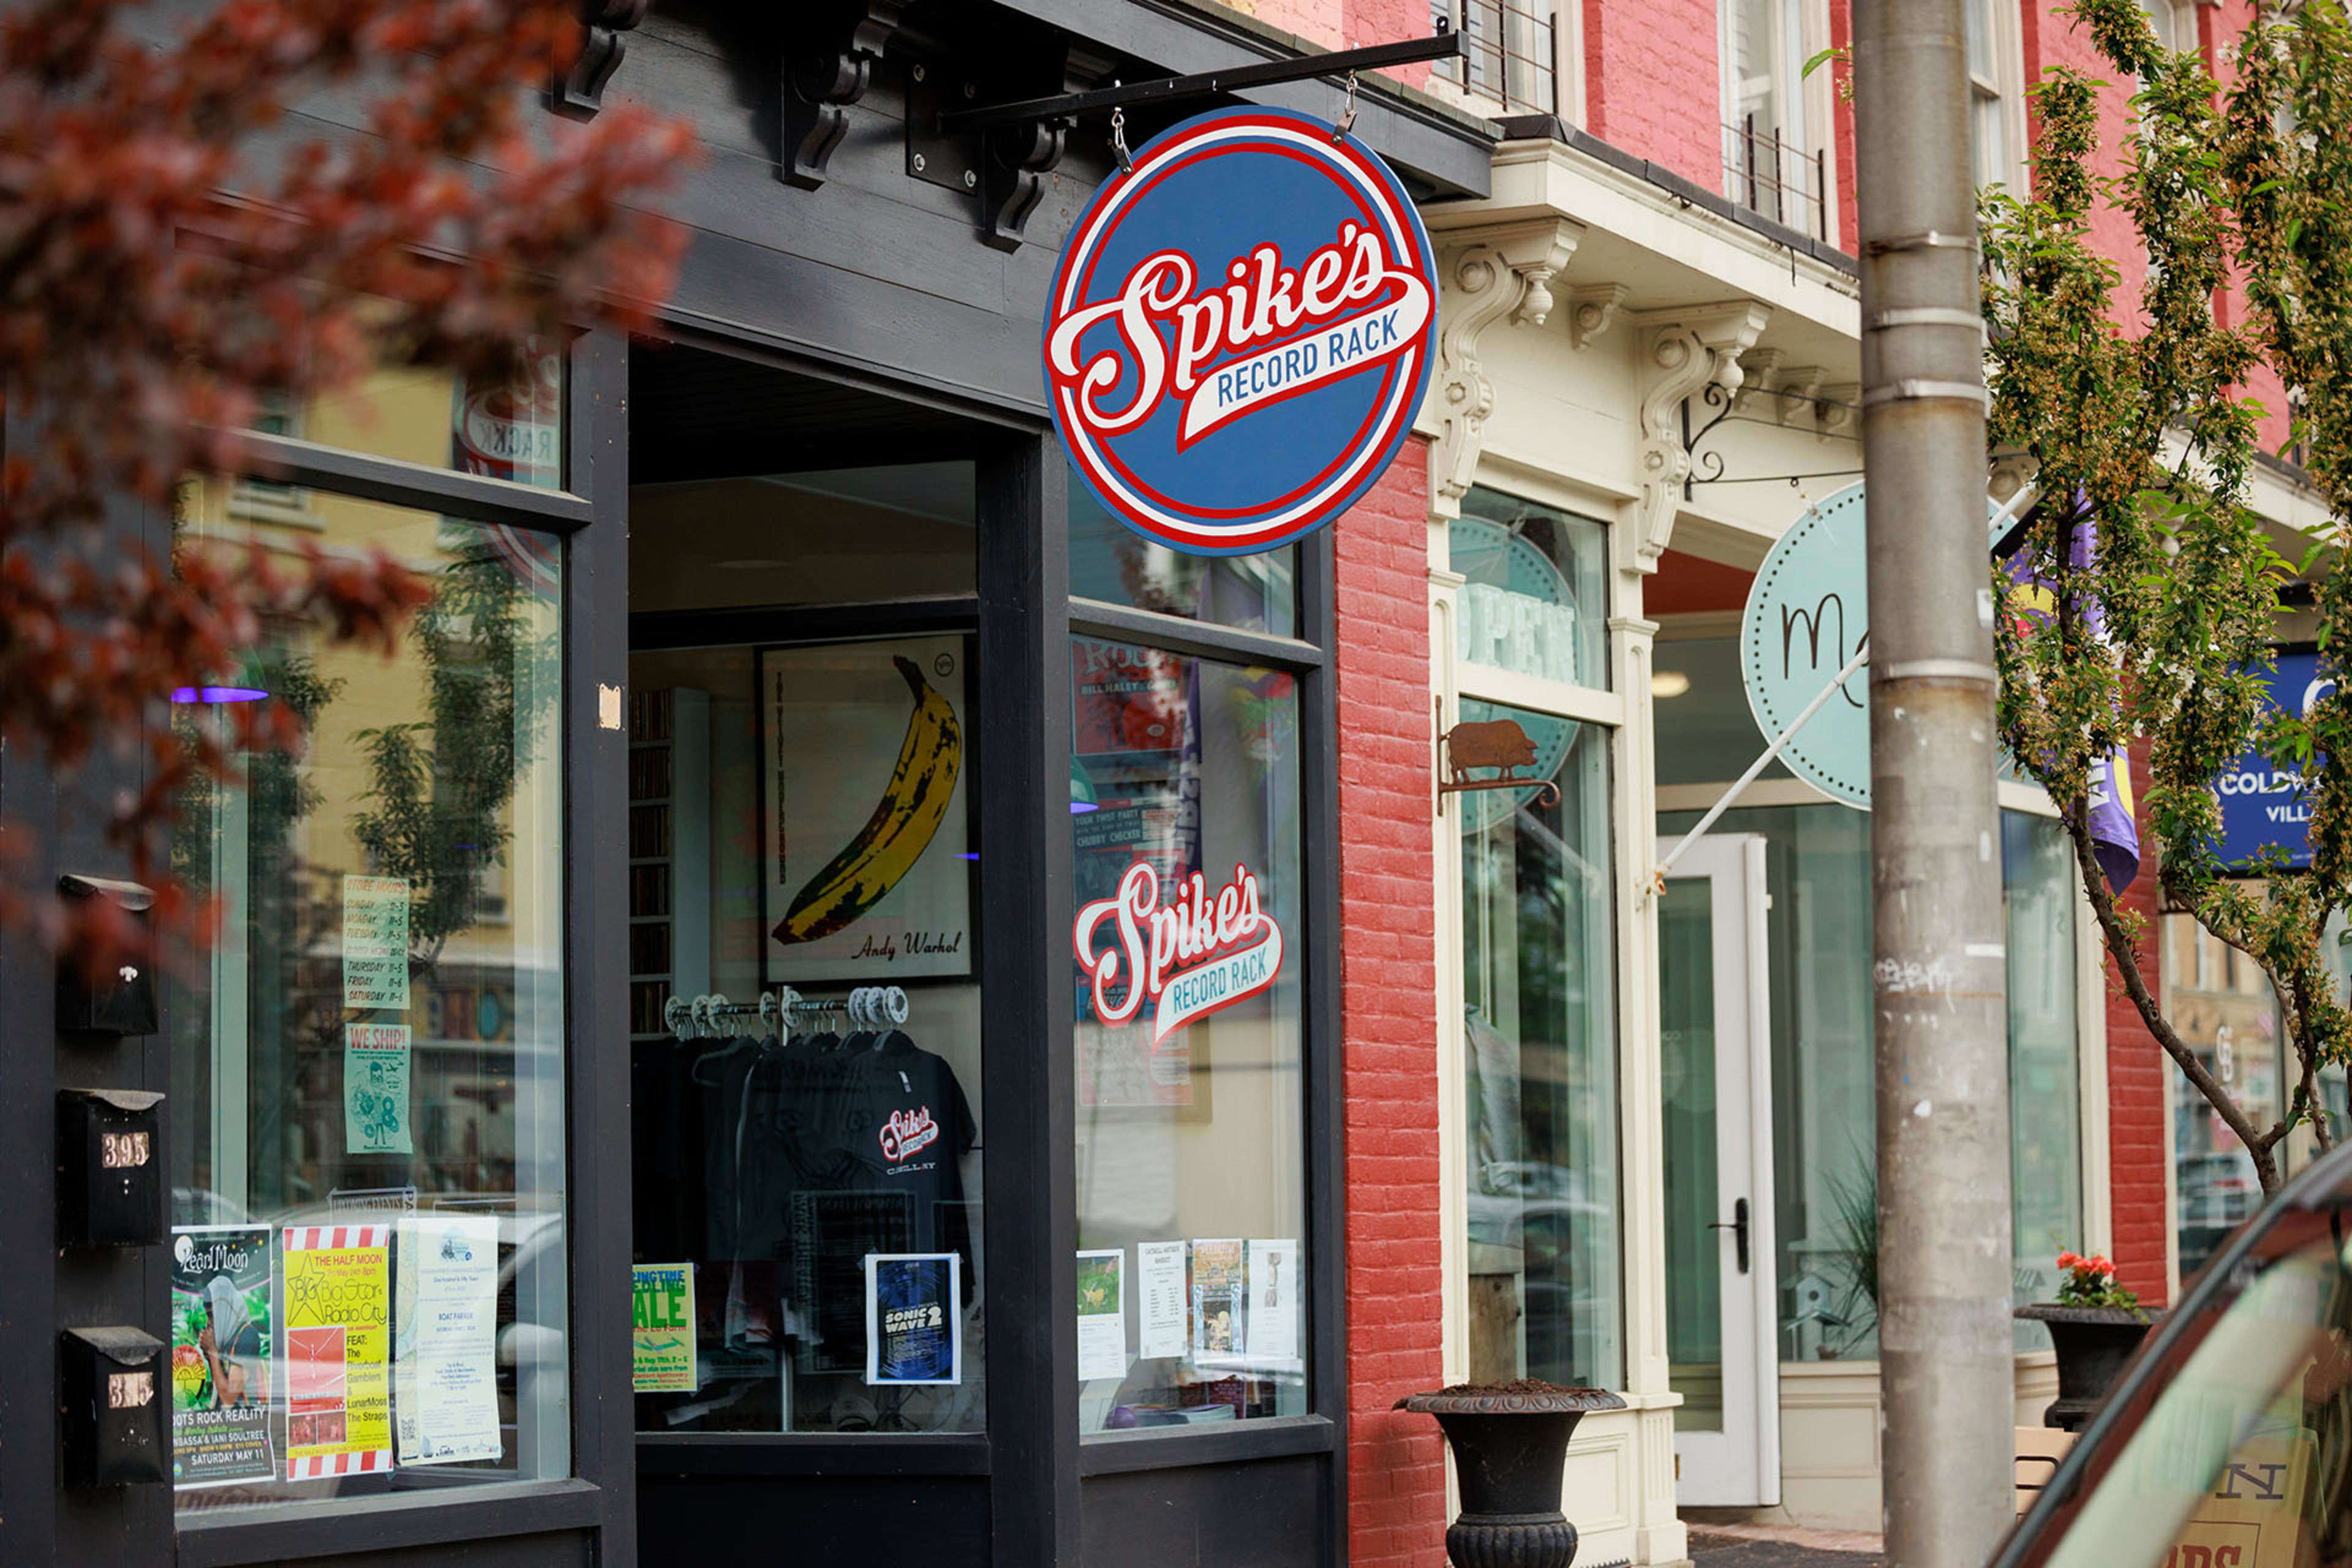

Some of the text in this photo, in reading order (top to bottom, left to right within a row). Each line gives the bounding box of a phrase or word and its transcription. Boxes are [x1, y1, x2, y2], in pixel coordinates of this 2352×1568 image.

[1047, 221, 1387, 432] Spike's
[1217, 308, 1399, 408] RECORD RACK
[346, 879, 374, 892] STORE
[851, 931, 962, 961] Andy Warhol
[1074, 862, 1261, 1023] Spike's
[347, 961, 385, 973] THURSDAY
[347, 975, 374, 987] FRIDAY
[1173, 966, 1226, 1014] RECORD
[1232, 946, 1267, 991] RACK
[348, 990, 386, 1001] SATURDAY
[350, 1027, 406, 1050] WE SHIP!
[180, 1243, 249, 1274] Pearl Moon
[315, 1254, 382, 1266] THE HALF MOON
[885, 1307, 927, 1324] SONIC
[927, 1305, 942, 1327] 2
[885, 1318, 925, 1333] WAVE
[347, 1334, 368, 1346] FEAT:
[347, 1348, 361, 1359] The
[197, 1411, 224, 1425] ROCK
[225, 1408, 266, 1423] REALITY
[347, 1411, 388, 1423] The Straps
[191, 1448, 265, 1466] SATURDAY MAY 11
